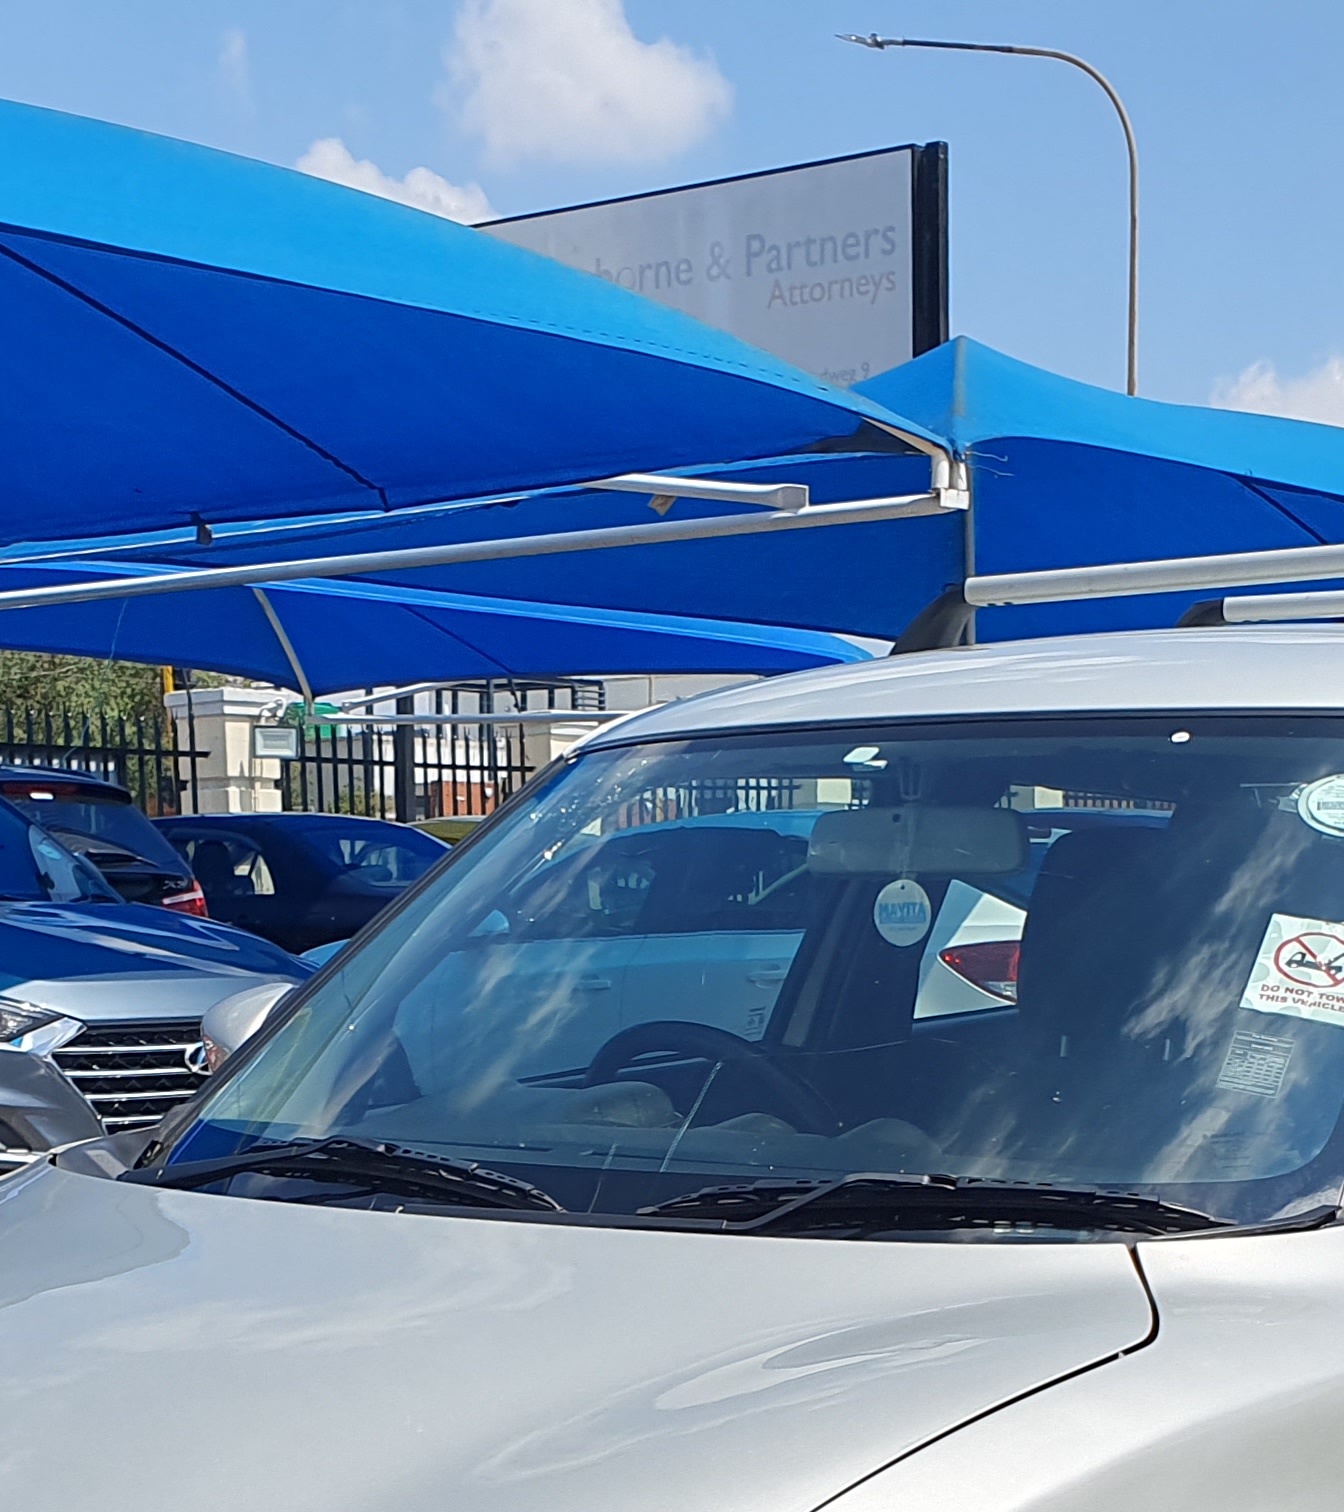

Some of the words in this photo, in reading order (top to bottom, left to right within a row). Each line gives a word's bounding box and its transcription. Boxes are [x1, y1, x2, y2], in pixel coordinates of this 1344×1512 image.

[706, 240, 732, 282] &
[745, 223, 897, 278] Partners
[766, 268, 897, 310] Attorneys
[1258, 993, 1288, 1003] THIS
[1260, 983, 1281, 992] DO
[1284, 986, 1314, 998] NOT
